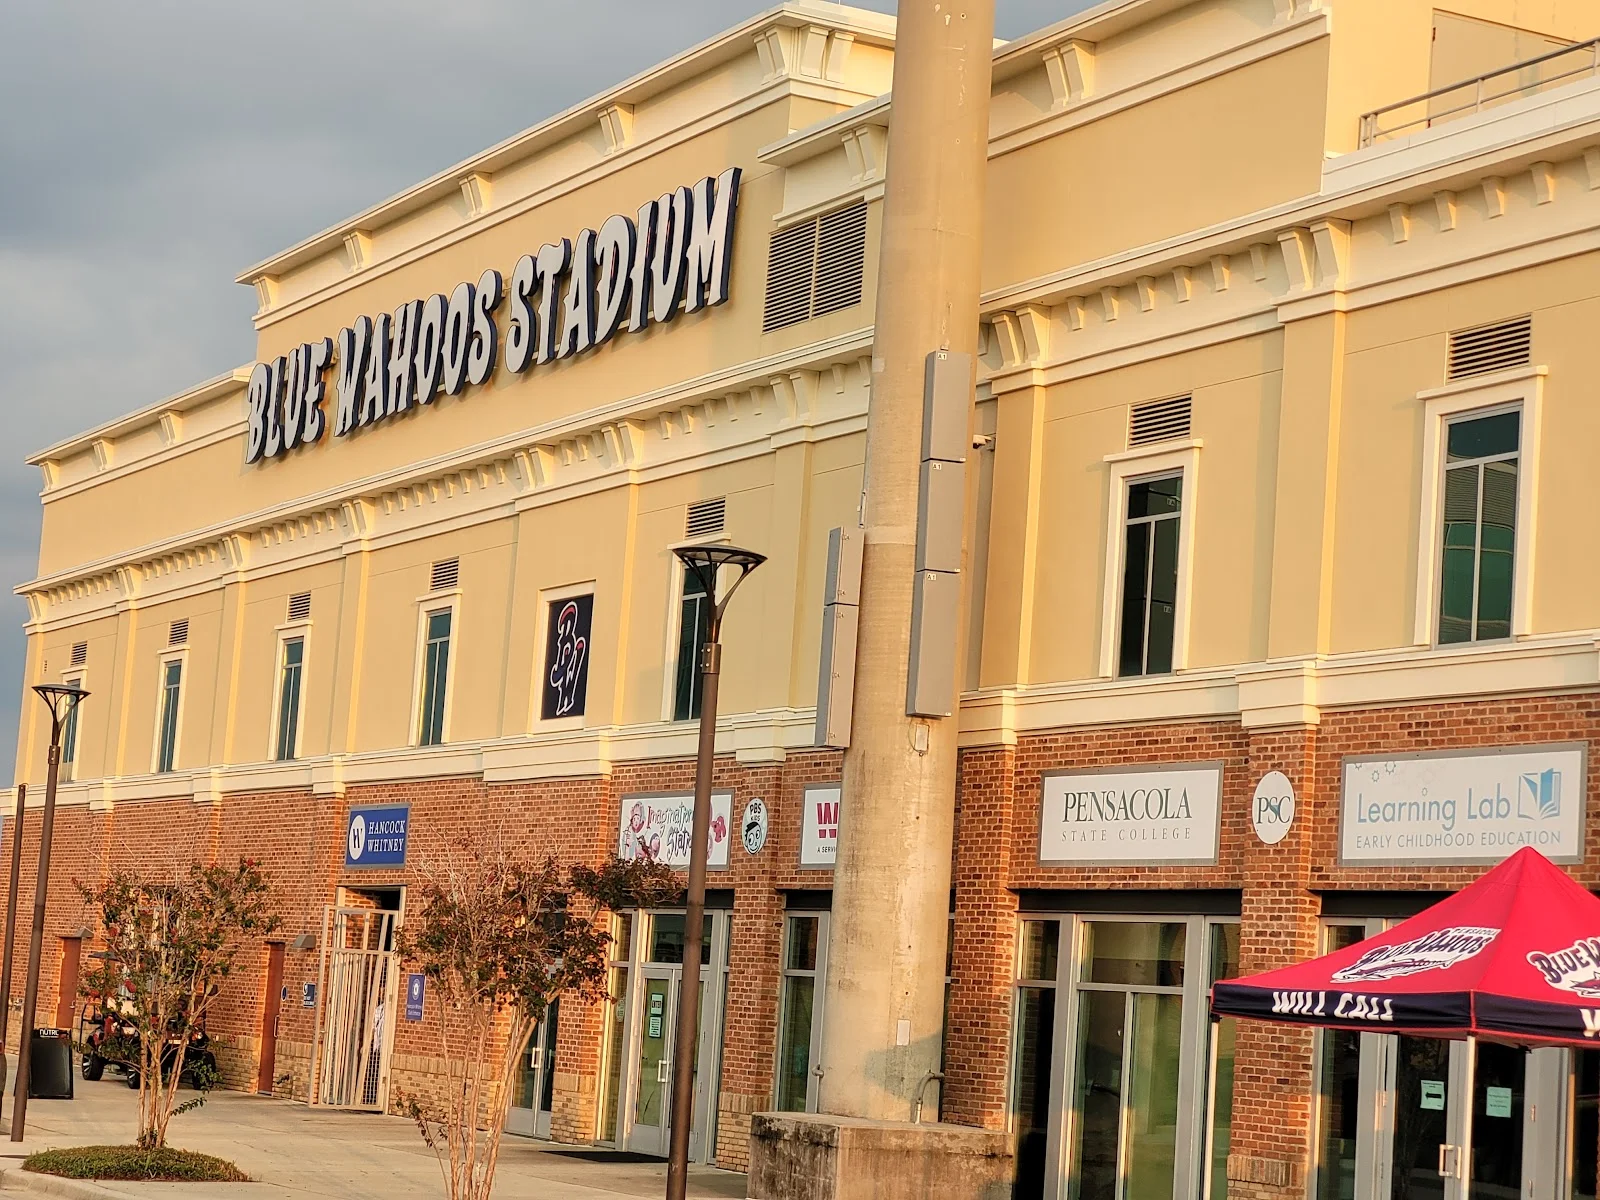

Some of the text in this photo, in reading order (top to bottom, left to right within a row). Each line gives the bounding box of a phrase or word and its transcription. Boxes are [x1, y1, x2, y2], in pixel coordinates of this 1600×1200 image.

[245, 167, 742, 464] BLUE WAHOOS STADIUM
[750, 803, 762, 815] PBS
[1062, 787, 1193, 823] PENSACOLA
[1256, 796, 1291, 824] PSC
[1357, 783, 1511, 831] Learning Lab
[368, 820, 406, 835] HANCOCK
[1062, 828, 1191, 842] STATE COLLEGE
[367, 838, 404, 852] WHITNEY
[1356, 831, 1561, 849] EARLY CHILDHOOD EDUCATION
[1272, 991, 1394, 1021] WILL CALL
